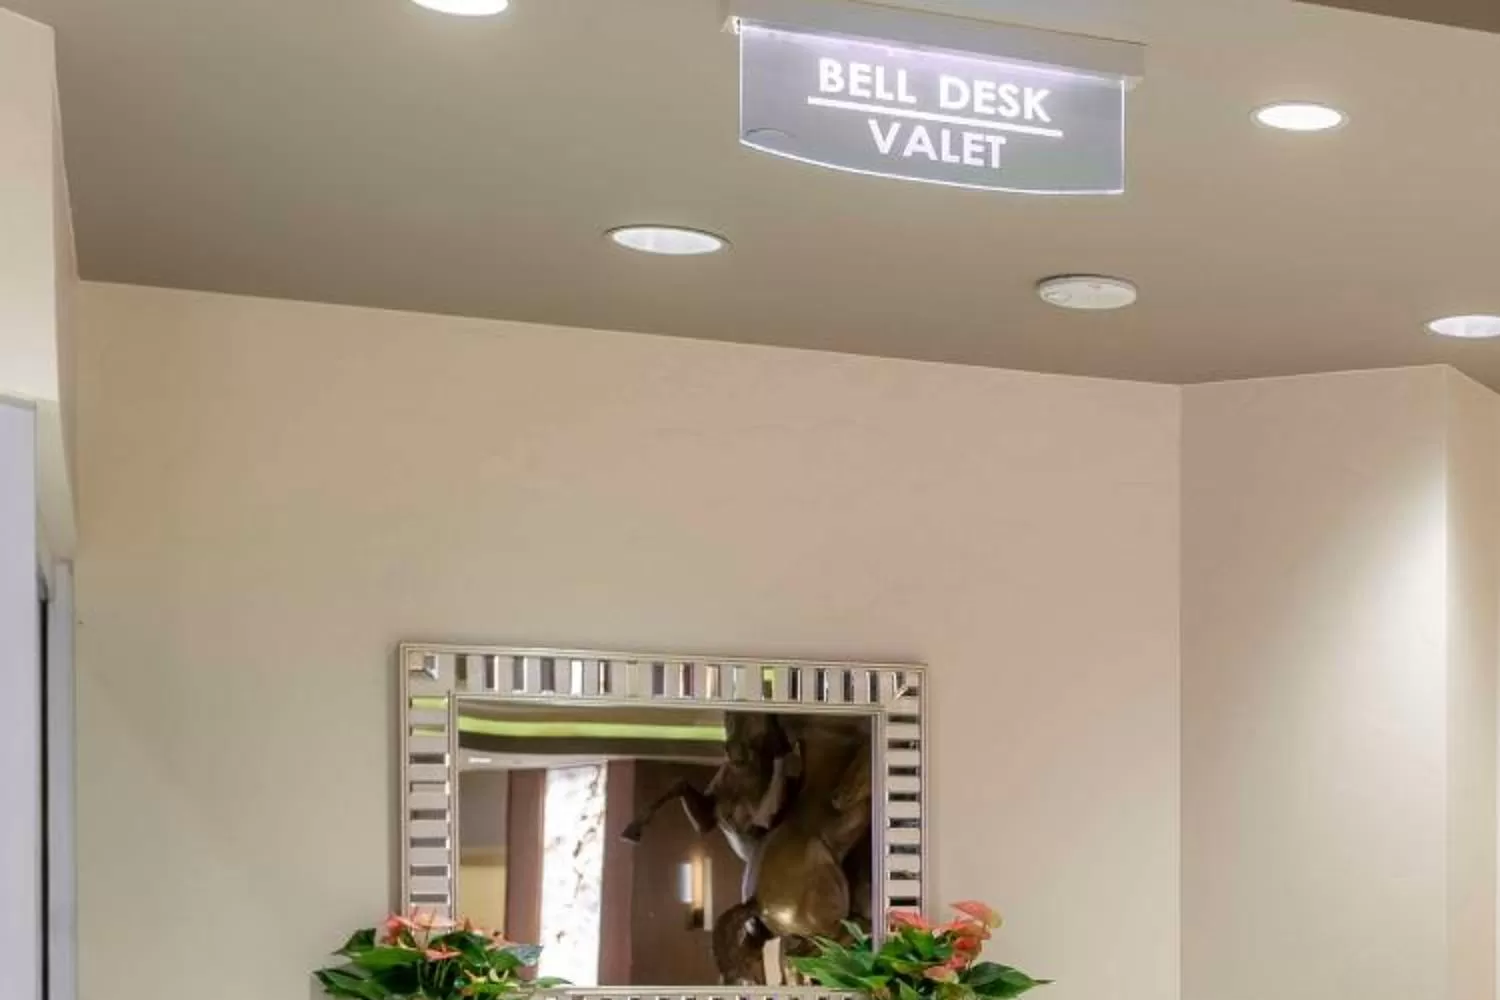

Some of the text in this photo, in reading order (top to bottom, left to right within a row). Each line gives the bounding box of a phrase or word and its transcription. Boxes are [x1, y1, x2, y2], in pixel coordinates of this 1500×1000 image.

[818, 57, 1053, 123] BELL DESK
[867, 118, 1007, 169] VALET
